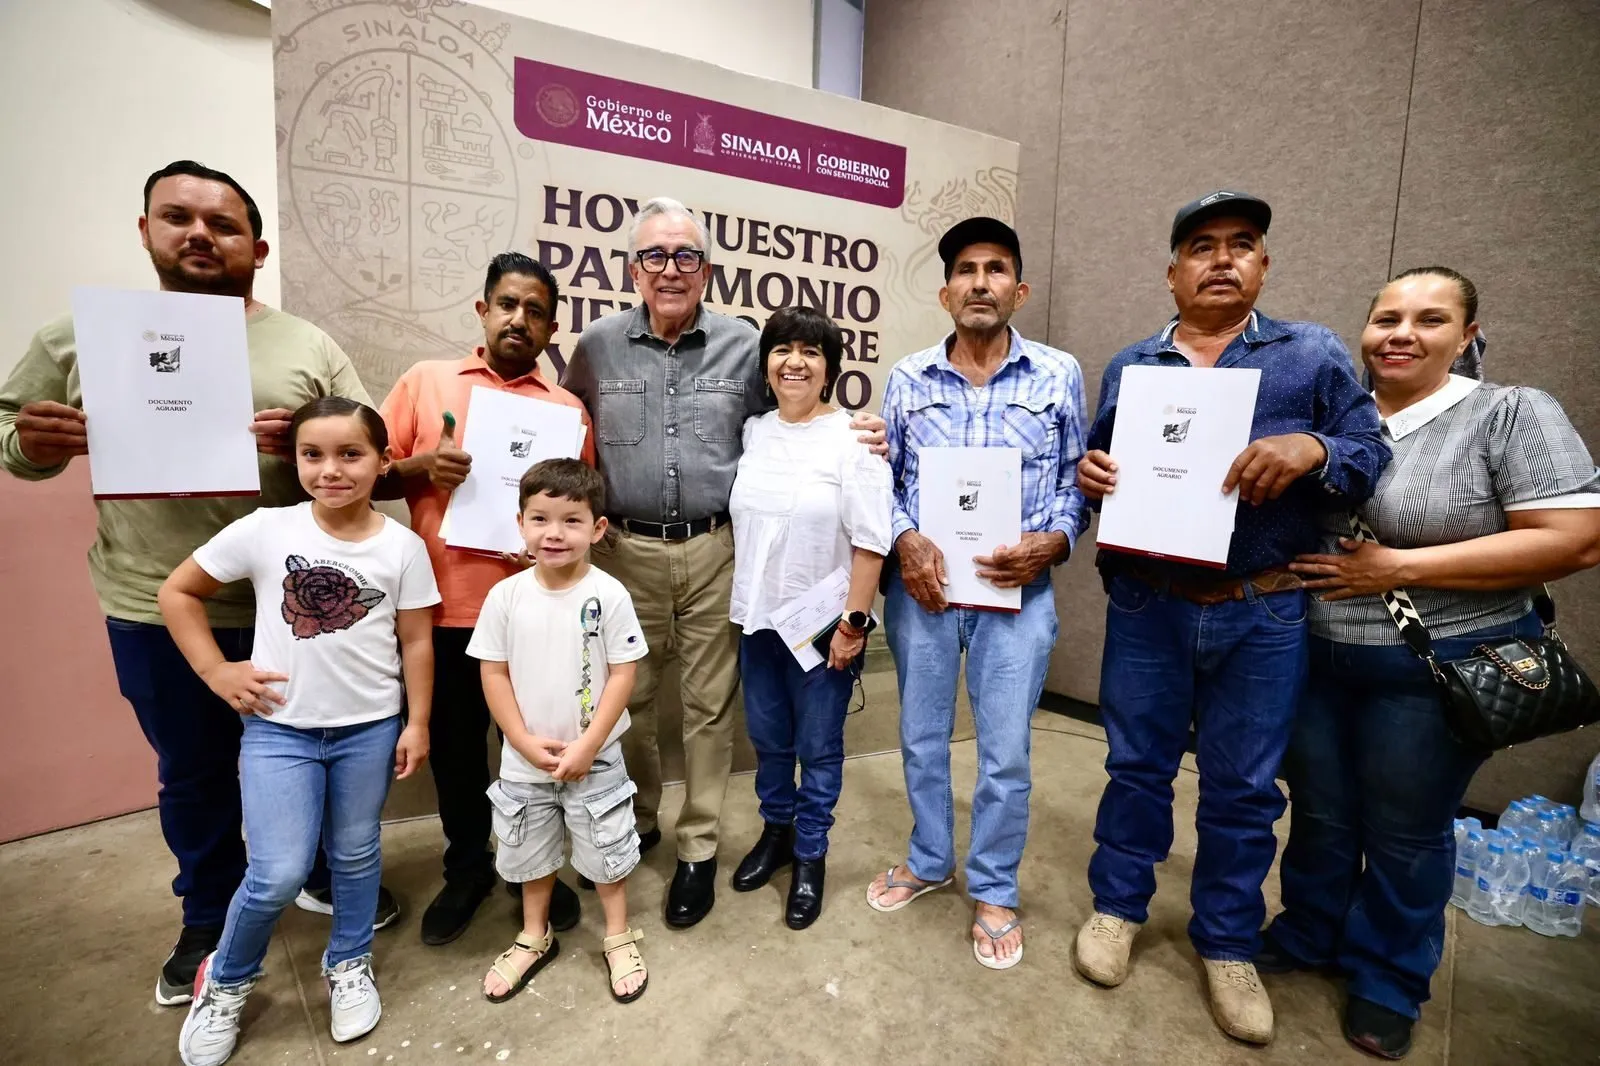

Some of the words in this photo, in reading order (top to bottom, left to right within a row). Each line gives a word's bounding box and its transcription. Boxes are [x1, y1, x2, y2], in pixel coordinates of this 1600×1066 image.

[342, 20, 473, 70] SINALOA
[586, 95, 653, 119] Gobierno
[656, 109, 672, 122] de
[586, 107, 672, 143] México
[721, 133, 801, 164] SINALOA
[816, 166, 832, 176] CON
[832, 169, 864, 183] SENTIDO
[864, 176, 890, 189] SOCIAL
[817, 153, 890, 180] GOBIERNO
[536, 239, 881, 323] PATMONIO
[1153, 466, 1188, 474] DOCUMENTO
[312, 559, 369, 587] ABERCROMBIE
